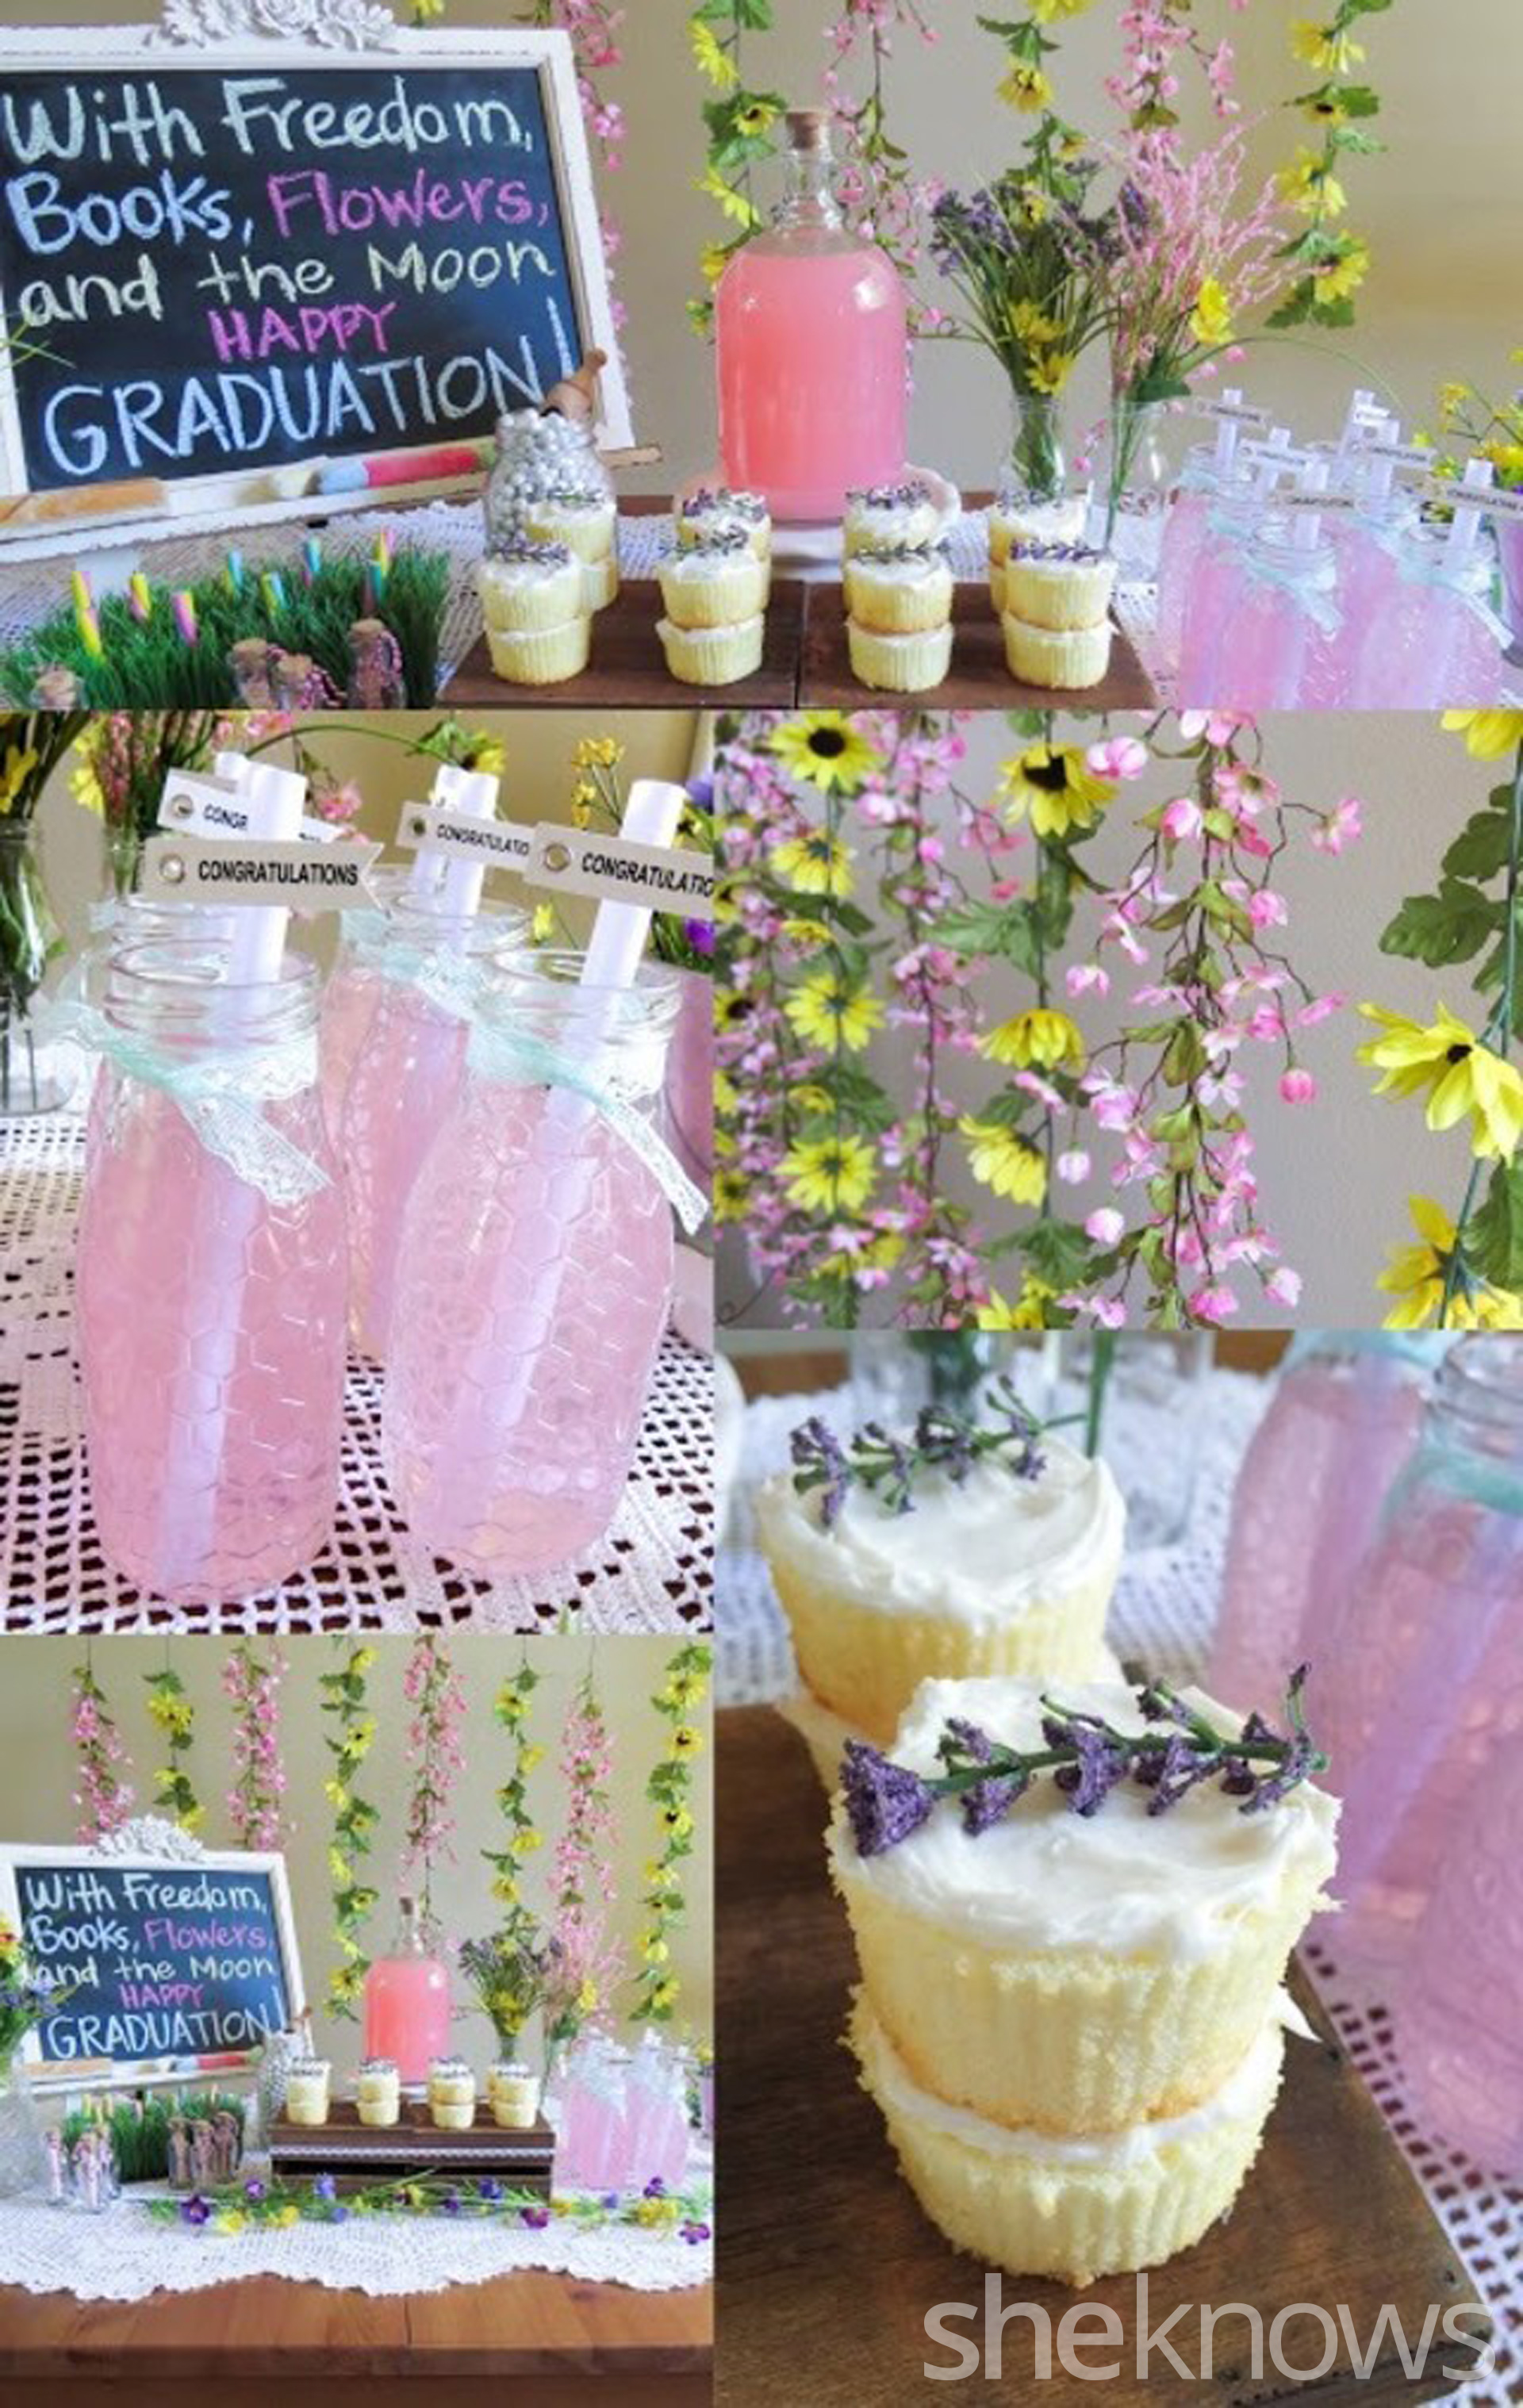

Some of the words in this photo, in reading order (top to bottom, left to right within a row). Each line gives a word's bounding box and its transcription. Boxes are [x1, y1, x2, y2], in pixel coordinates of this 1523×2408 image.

[3, 81, 205, 167] With
[222, 76, 533, 154] Freedom,
[6, 169, 254, 255] Books,
[267, 167, 551, 238] Flowers,
[18, 252, 163, 327] and
[197, 250, 335, 305] the
[367, 240, 555, 294] Moon
[209, 301, 397, 363] HAPPY
[198, 859, 359, 887] CONGRATULATIONS
[26, 1873, 117, 1914] With
[123, 1872, 268, 1915] Freedom,
[30, 1914, 141, 1954] Books,
[36, 1954, 100, 1988] and
[113, 1955, 176, 1984] the
[190, 1954, 276, 1980] Moon
[119, 1983, 205, 2010] HAPPY
